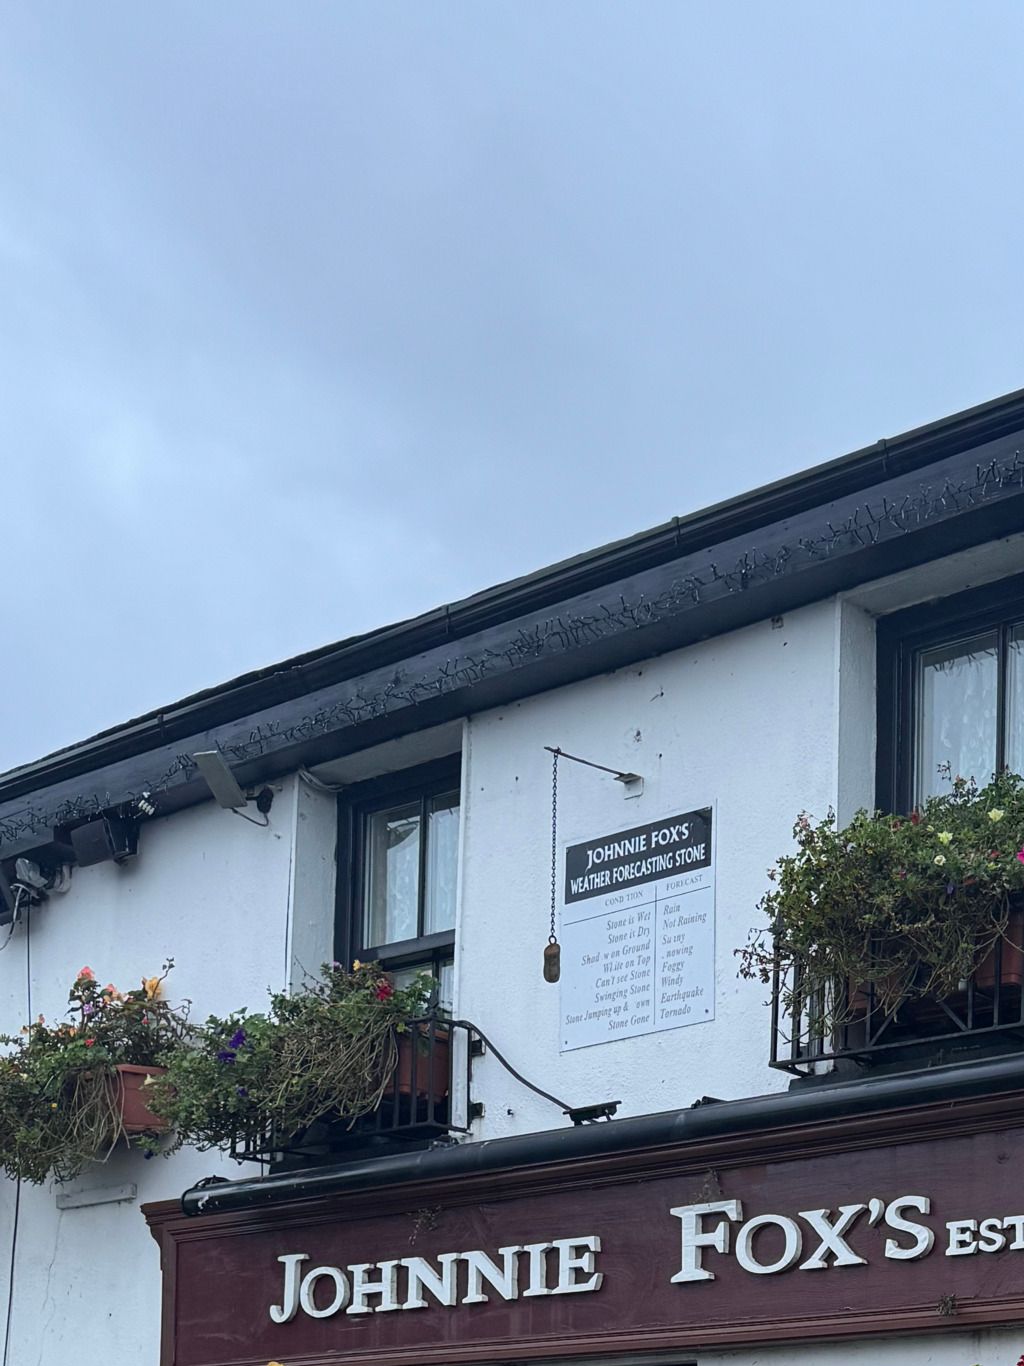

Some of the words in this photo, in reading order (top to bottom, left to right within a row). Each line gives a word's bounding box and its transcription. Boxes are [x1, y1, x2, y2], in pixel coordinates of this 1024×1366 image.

[586, 834, 647, 869] JOHNNIE
[651, 823, 689, 848] FOX'S
[570, 870, 611, 895] WEATHER
[612, 852, 673, 883] FORECASTING
[675, 843, 706, 866] STONE
[666, 874, 703, 891] FORECAST
[604, 889, 643, 907] CONDTION
[663, 904, 681, 916] Rain
[606, 918, 627, 931] Stone
[662, 918, 676, 930] Not
[678, 911, 707, 927] Raining
[608, 931, 628, 944] Stone
[638, 925, 650, 938] Dry
[581, 951, 609, 966] Shadw
[622, 939, 651, 956] Ground
[636, 954, 651, 967] Top
[661, 944, 693, 960] nowing
[630, 969, 651, 981] Stone
[662, 960, 686, 973] Foggy
[661, 973, 684, 988] Windy
[594, 988, 628, 1003] Swinging
[630, 983, 651, 995] Stone
[660, 986, 704, 1003] Earthquake
[565, 1012, 582, 1025] Stone
[583, 1004, 612, 1022] Jumping
[634, 998, 650, 1009] own
[660, 1003, 692, 1020] Tornado
[608, 1018, 628, 1031] Stone
[630, 1013, 650, 1025] Gone
[270, 1235, 604, 1324] JOHNNIE
[670, 1195, 935, 1283] FOX'S
